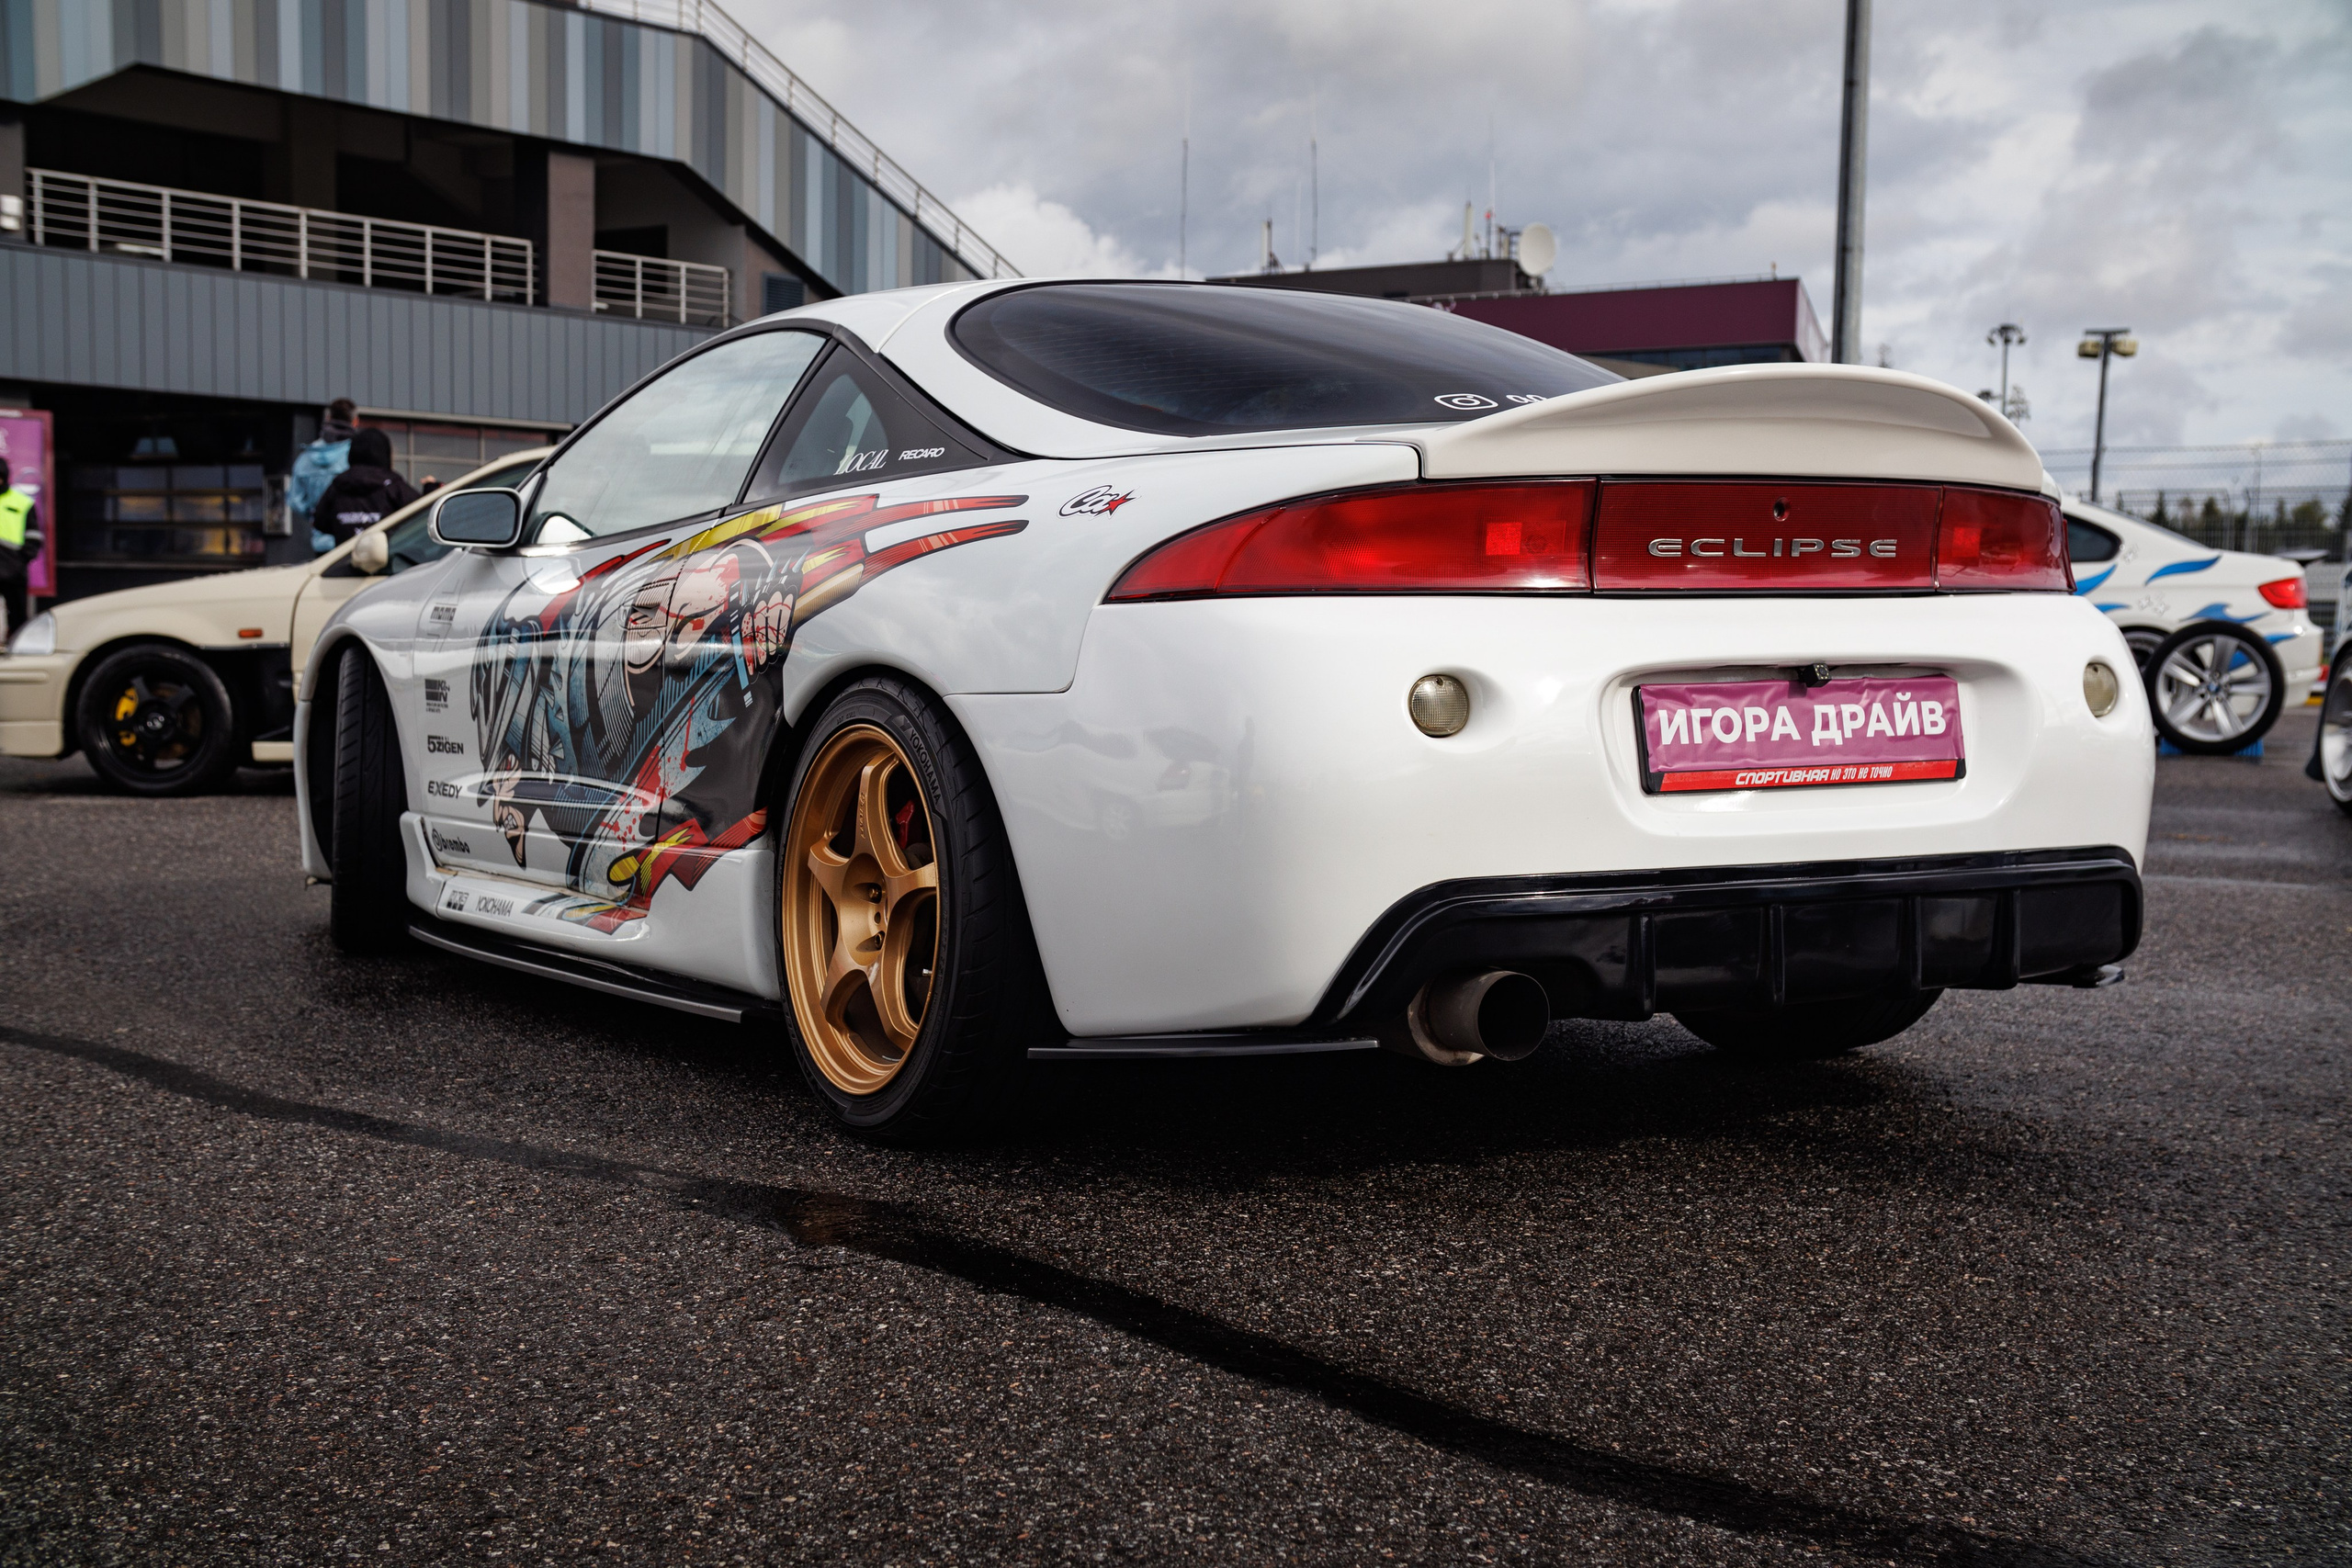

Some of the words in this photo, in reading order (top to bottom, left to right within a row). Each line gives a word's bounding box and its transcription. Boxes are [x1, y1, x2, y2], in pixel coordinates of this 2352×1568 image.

[833, 449, 889, 476] LOCAL
[899, 447, 945, 460] RECARO
[1648, 538, 1897, 558] ECLIPSE
[1658, 706, 1802, 745] ИГОРА
[1811, 692, 1947, 746] ДРАЙВ
[427, 735, 464, 754] 5ZIGEN
[909, 728, 943, 805] YOKOHAMA
[1842, 768, 1858, 780] ЭТО
[1870, 765, 1894, 778] ТОЧНО
[427, 780, 462, 799] EXEDY
[438, 833, 470, 854] brembo
[475, 896, 514, 917] YOKOHAMA
